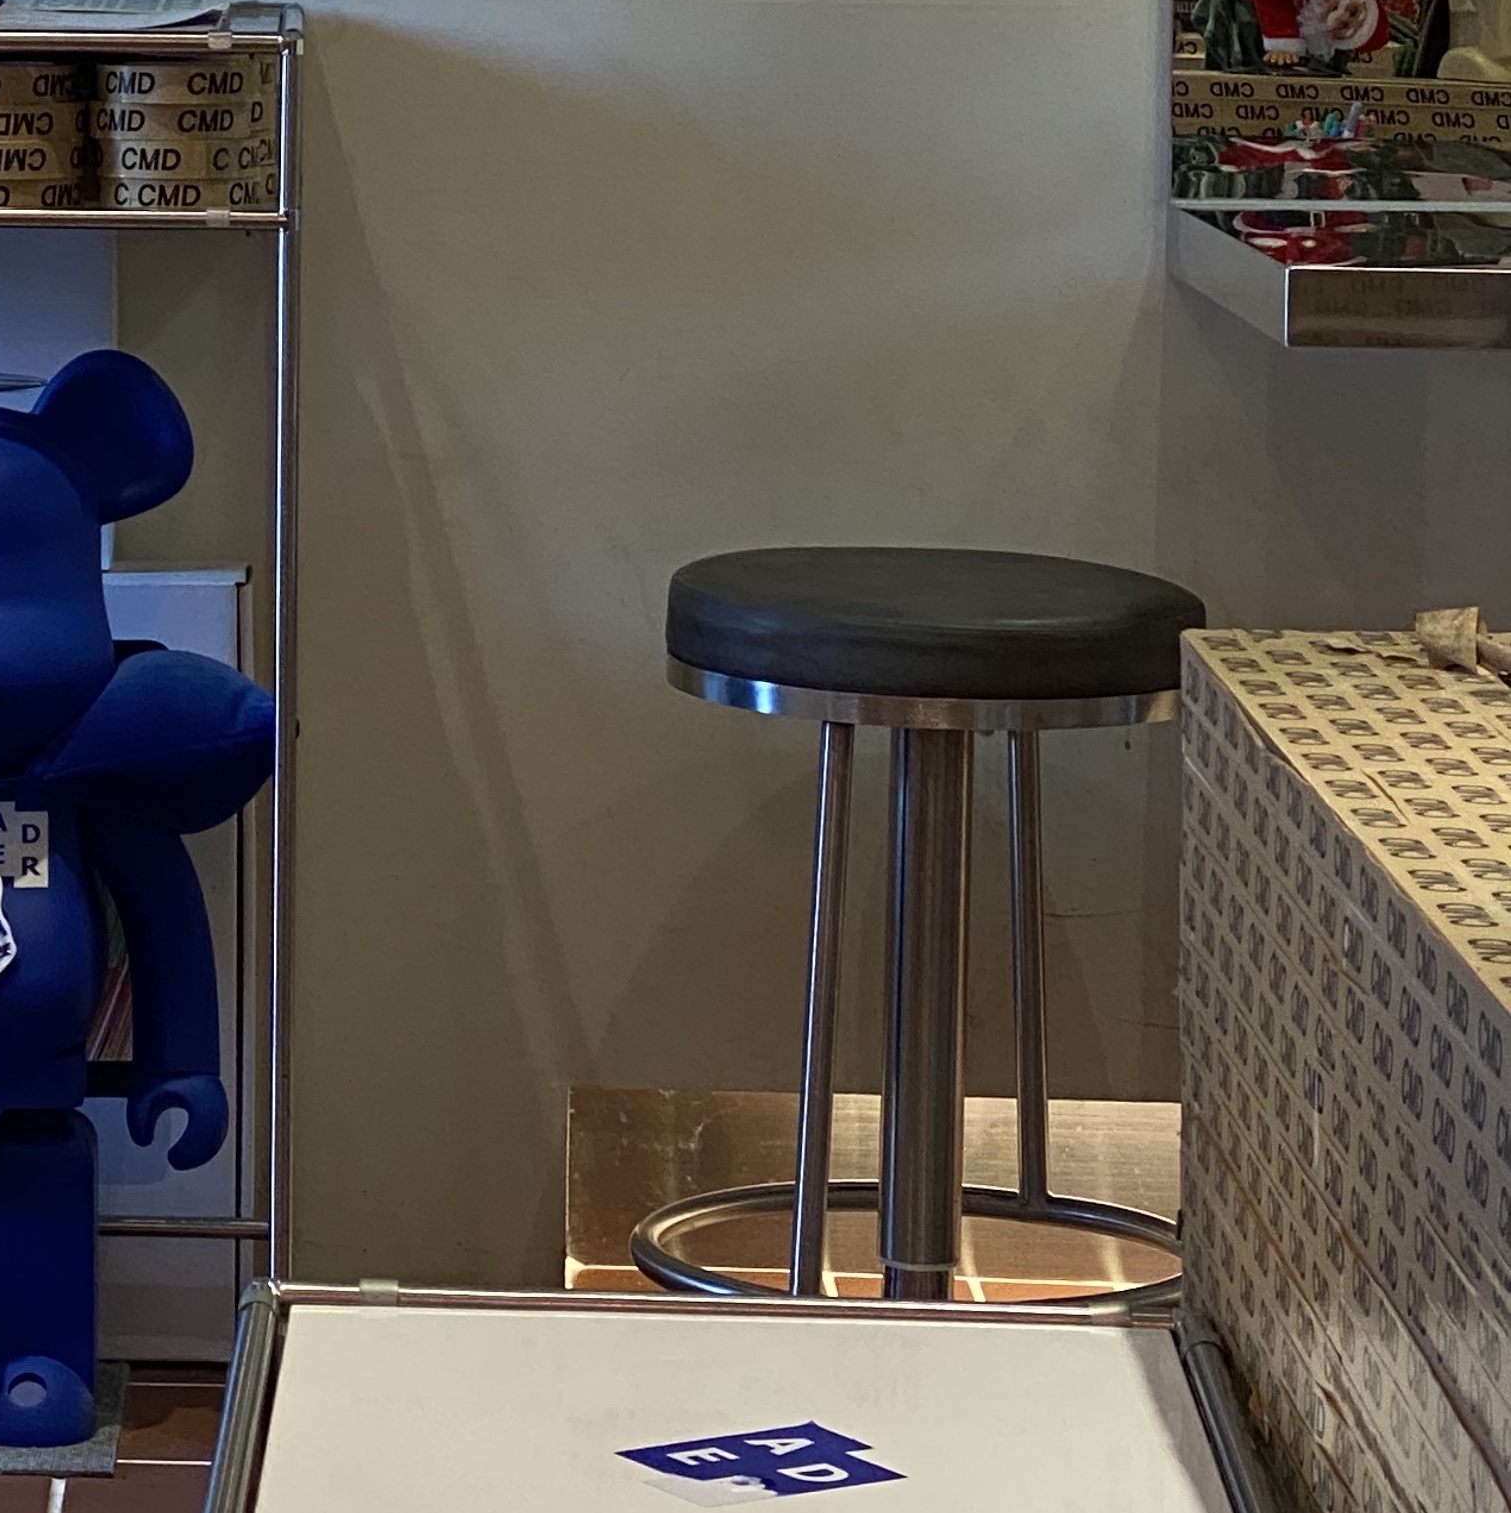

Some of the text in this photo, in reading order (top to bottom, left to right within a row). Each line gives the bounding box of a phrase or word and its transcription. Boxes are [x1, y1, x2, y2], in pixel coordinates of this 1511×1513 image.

[106, 71, 155, 94] CMD
[187, 72, 243, 95] CMD
[96, 109, 145, 131] CMD
[177, 109, 234, 132] CMD
[122, 147, 181, 171] CMD
[138, 184, 201, 207] CMD
[21, 824, 41, 845] D
[21, 858, 42, 876] R
